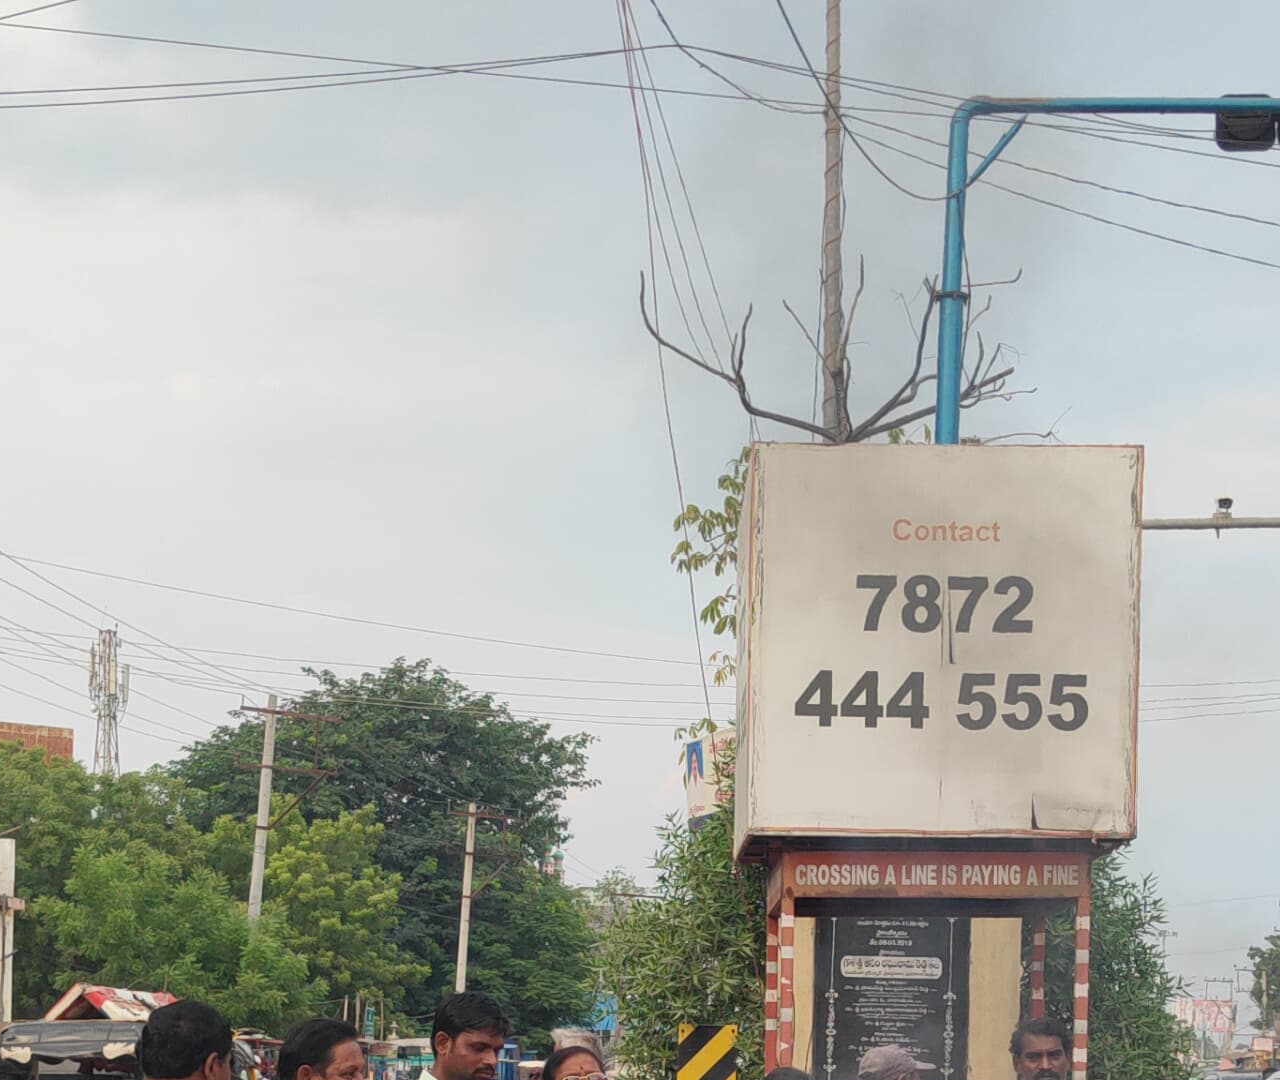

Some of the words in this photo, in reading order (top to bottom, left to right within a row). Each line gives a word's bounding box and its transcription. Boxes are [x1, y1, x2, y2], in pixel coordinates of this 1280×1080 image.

[892, 518, 1000, 543] Contact
[856, 575, 1034, 633] 7872
[795, 670, 929, 729] 444
[956, 673, 1089, 731] 555
[795, 864, 880, 886] CROSSING
[884, 864, 896, 886] A
[901, 864, 938, 886] LINE
[941, 864, 958, 886] IS
[962, 864, 1021, 886] PAYING
[1026, 865, 1039, 887] A
[1043, 865, 1079, 887] FINE
